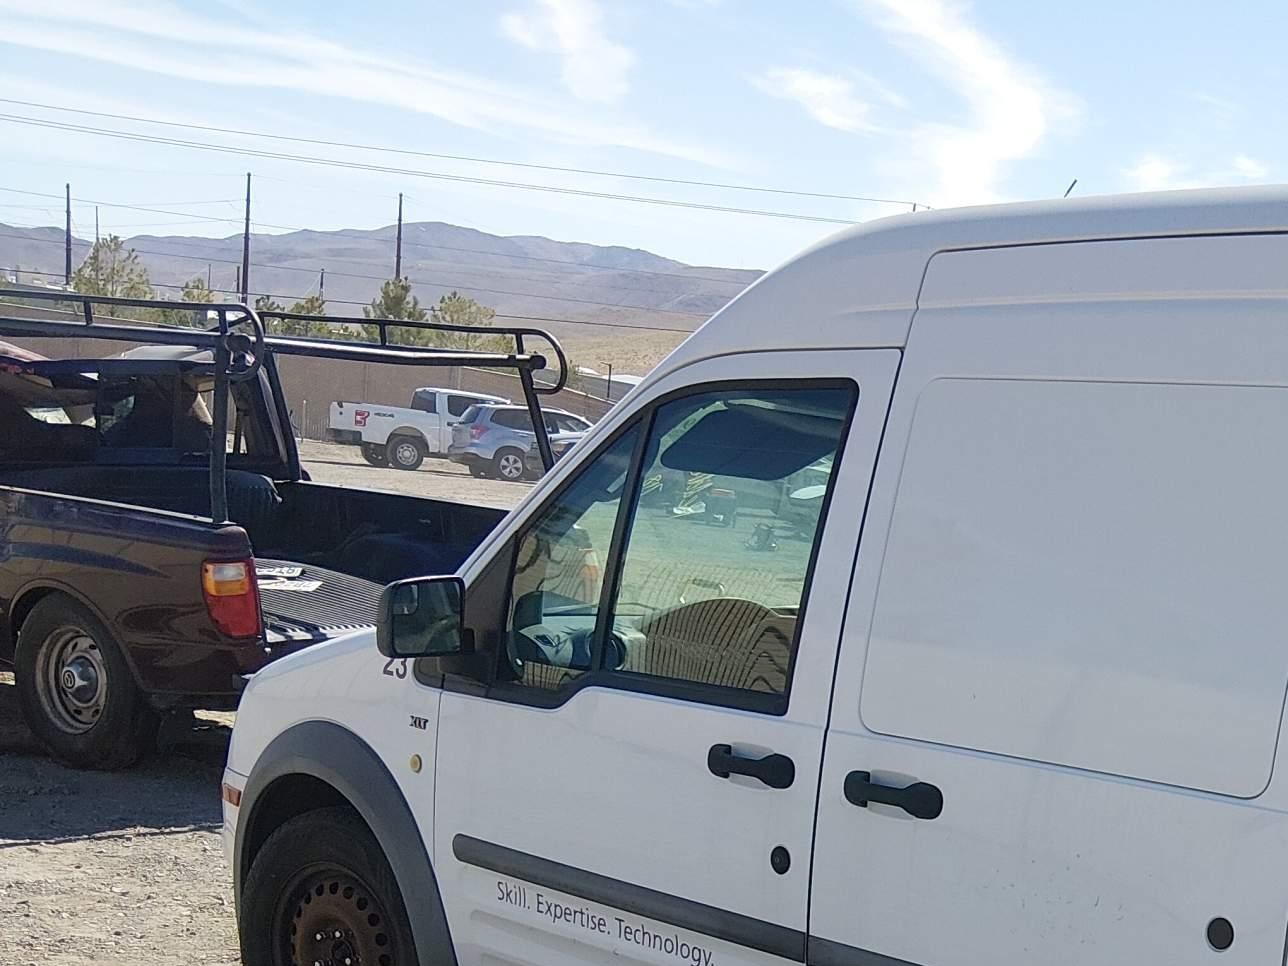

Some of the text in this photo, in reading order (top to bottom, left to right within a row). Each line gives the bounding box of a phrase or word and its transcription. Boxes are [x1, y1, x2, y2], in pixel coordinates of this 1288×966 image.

[383, 658, 407, 679] 23
[409, 715, 429, 730] XLT
[497, 881, 530, 909] Skill.
[536, 893, 611, 935] Expertise.
